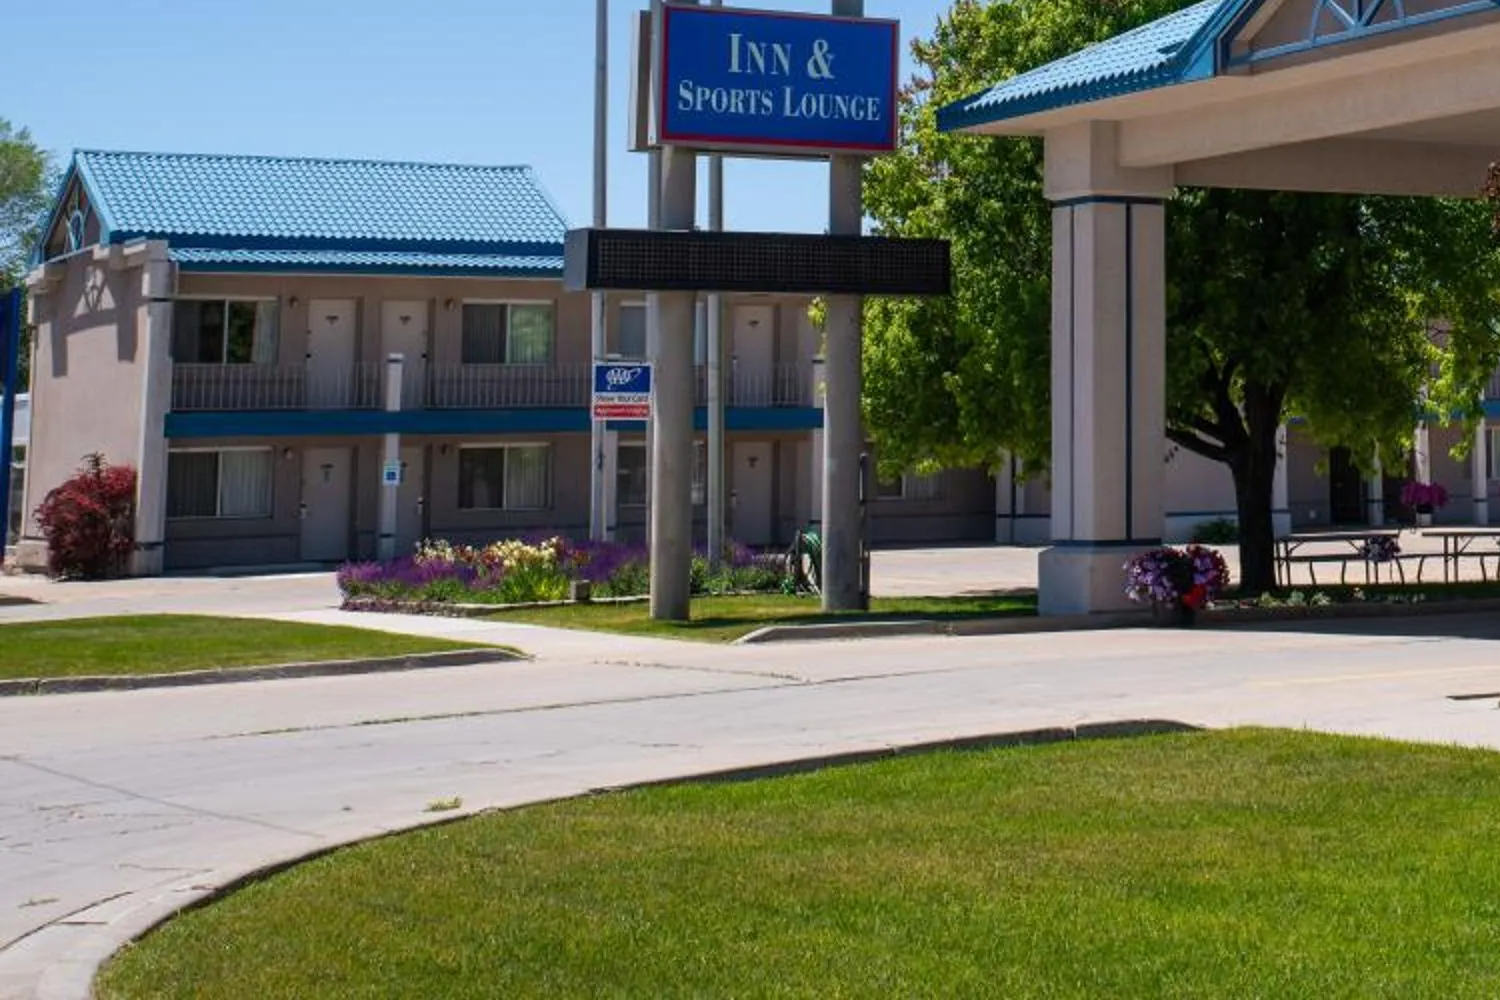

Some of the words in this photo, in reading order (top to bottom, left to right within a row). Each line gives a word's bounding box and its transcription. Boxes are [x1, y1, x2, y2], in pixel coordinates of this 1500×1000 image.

[728, 33, 790, 76] INN
[807, 39, 834, 80] &
[678, 80, 773, 117] SPORTS
[783, 86, 880, 121] LOUNGE
